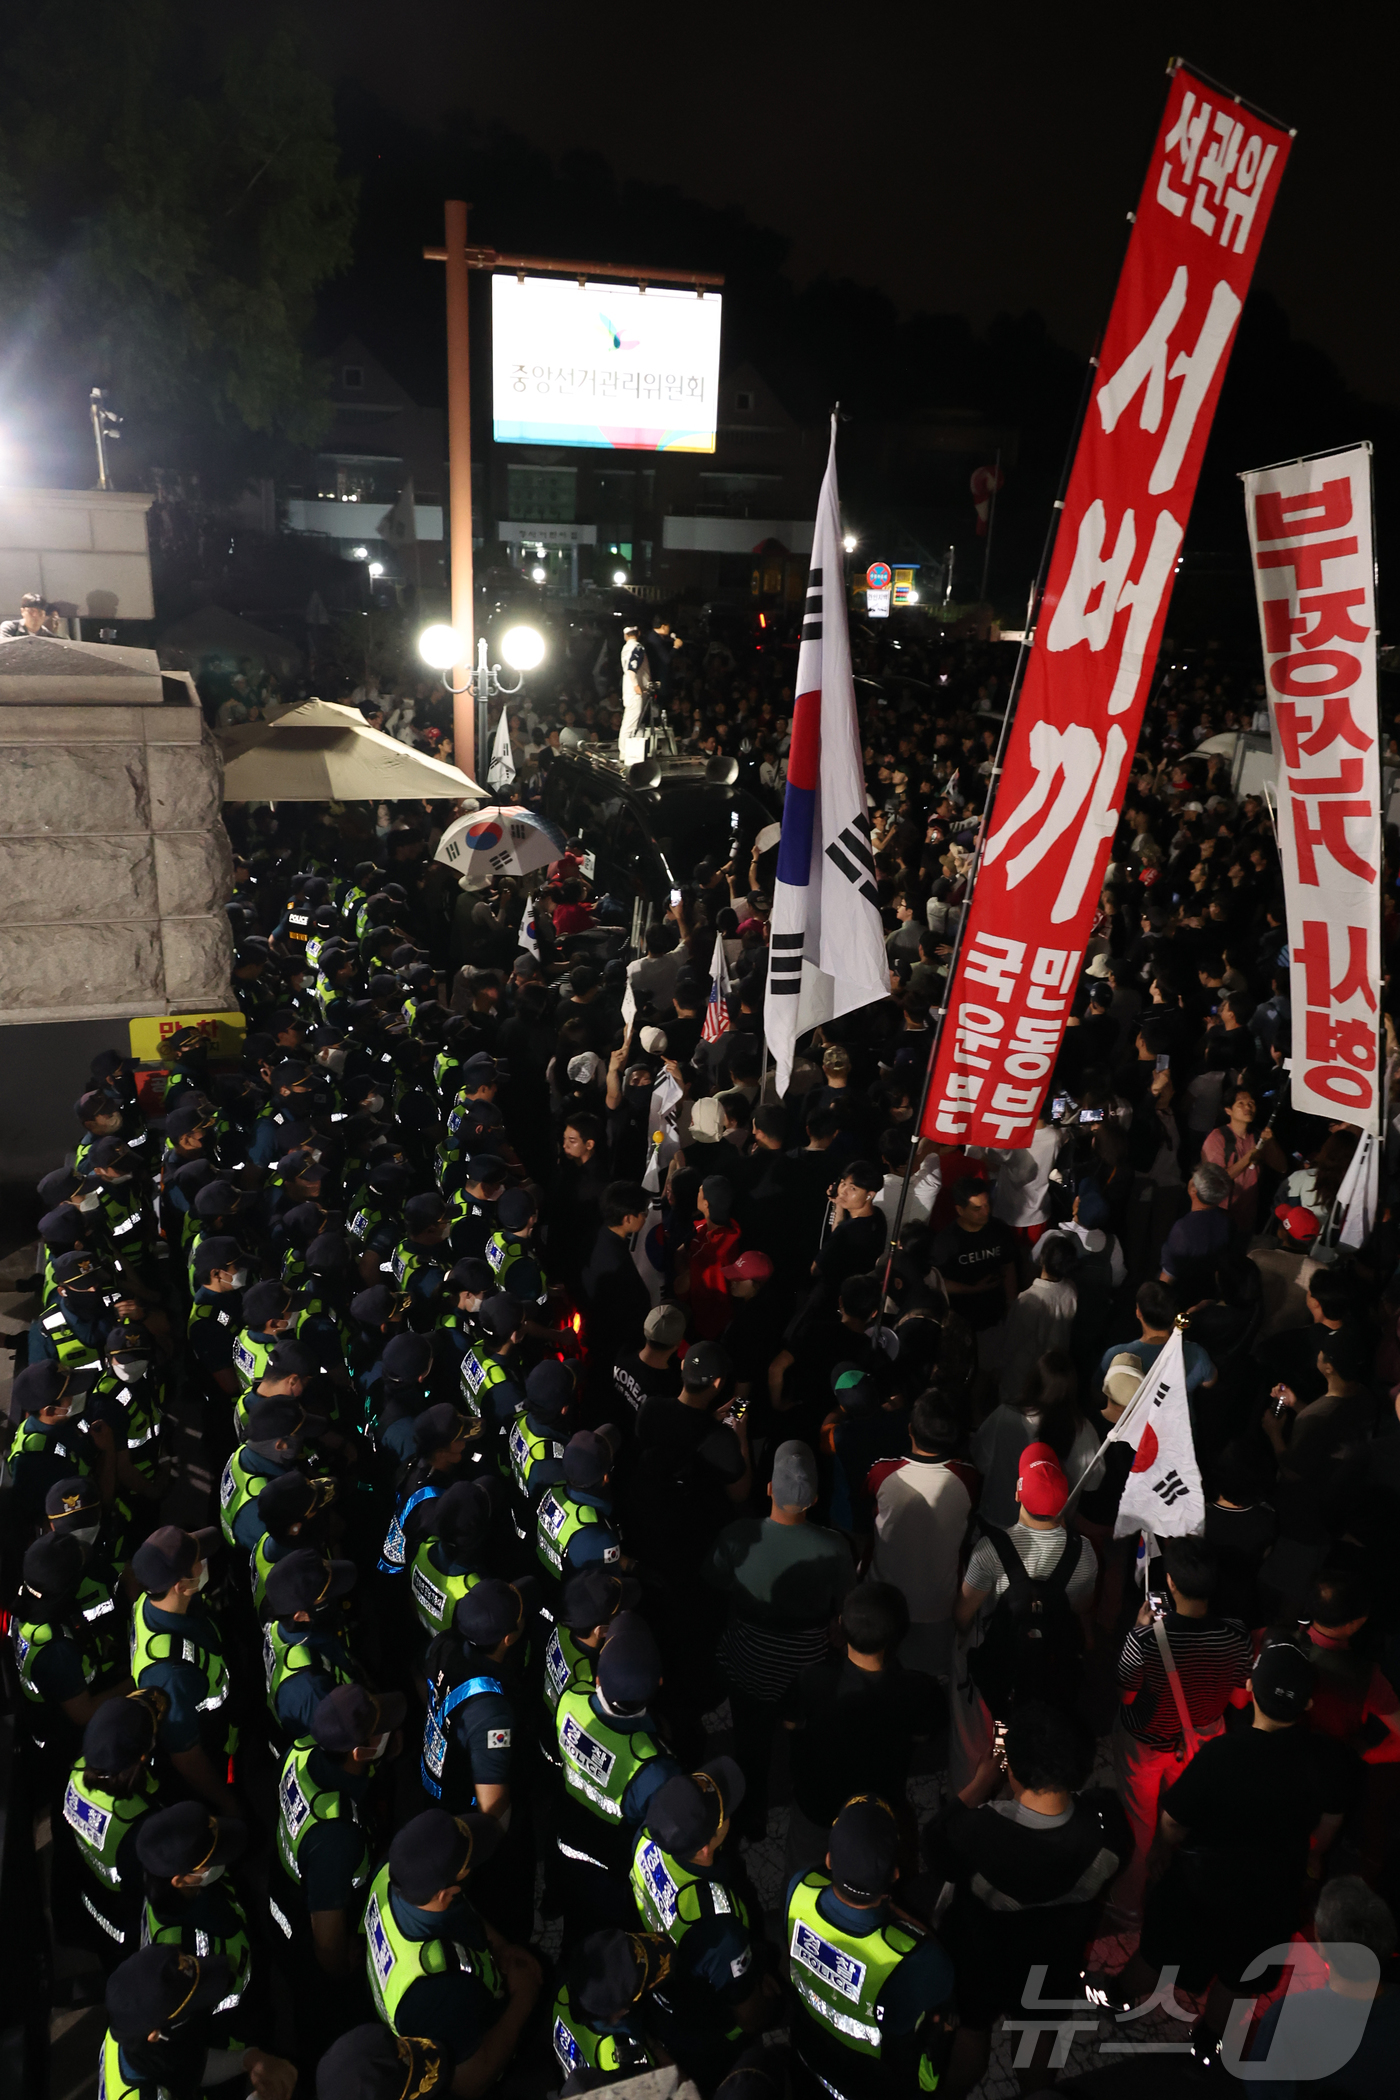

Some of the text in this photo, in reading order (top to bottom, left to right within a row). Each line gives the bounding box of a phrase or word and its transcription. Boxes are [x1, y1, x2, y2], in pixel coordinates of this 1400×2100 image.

[1156, 91, 1277, 254] 선관위
[510, 364, 704, 402] 중앙선거관리위원회
[982, 265, 1241, 924] 서버까
[964, 931, 1082, 1011] 국민
[954, 1003, 1063, 1080] 운동
[935, 1073, 1042, 1139] 본부
[958, 1245, 1001, 1265] CELINE
[613, 1366, 647, 1405] KOREA
[564, 1739, 602, 1779] POLICE
[565, 1721, 607, 1770] 경찰
[68, 1786, 102, 1830] 경찰
[800, 1950, 852, 1995] POLICE
[803, 1929, 856, 1982] 경찰
